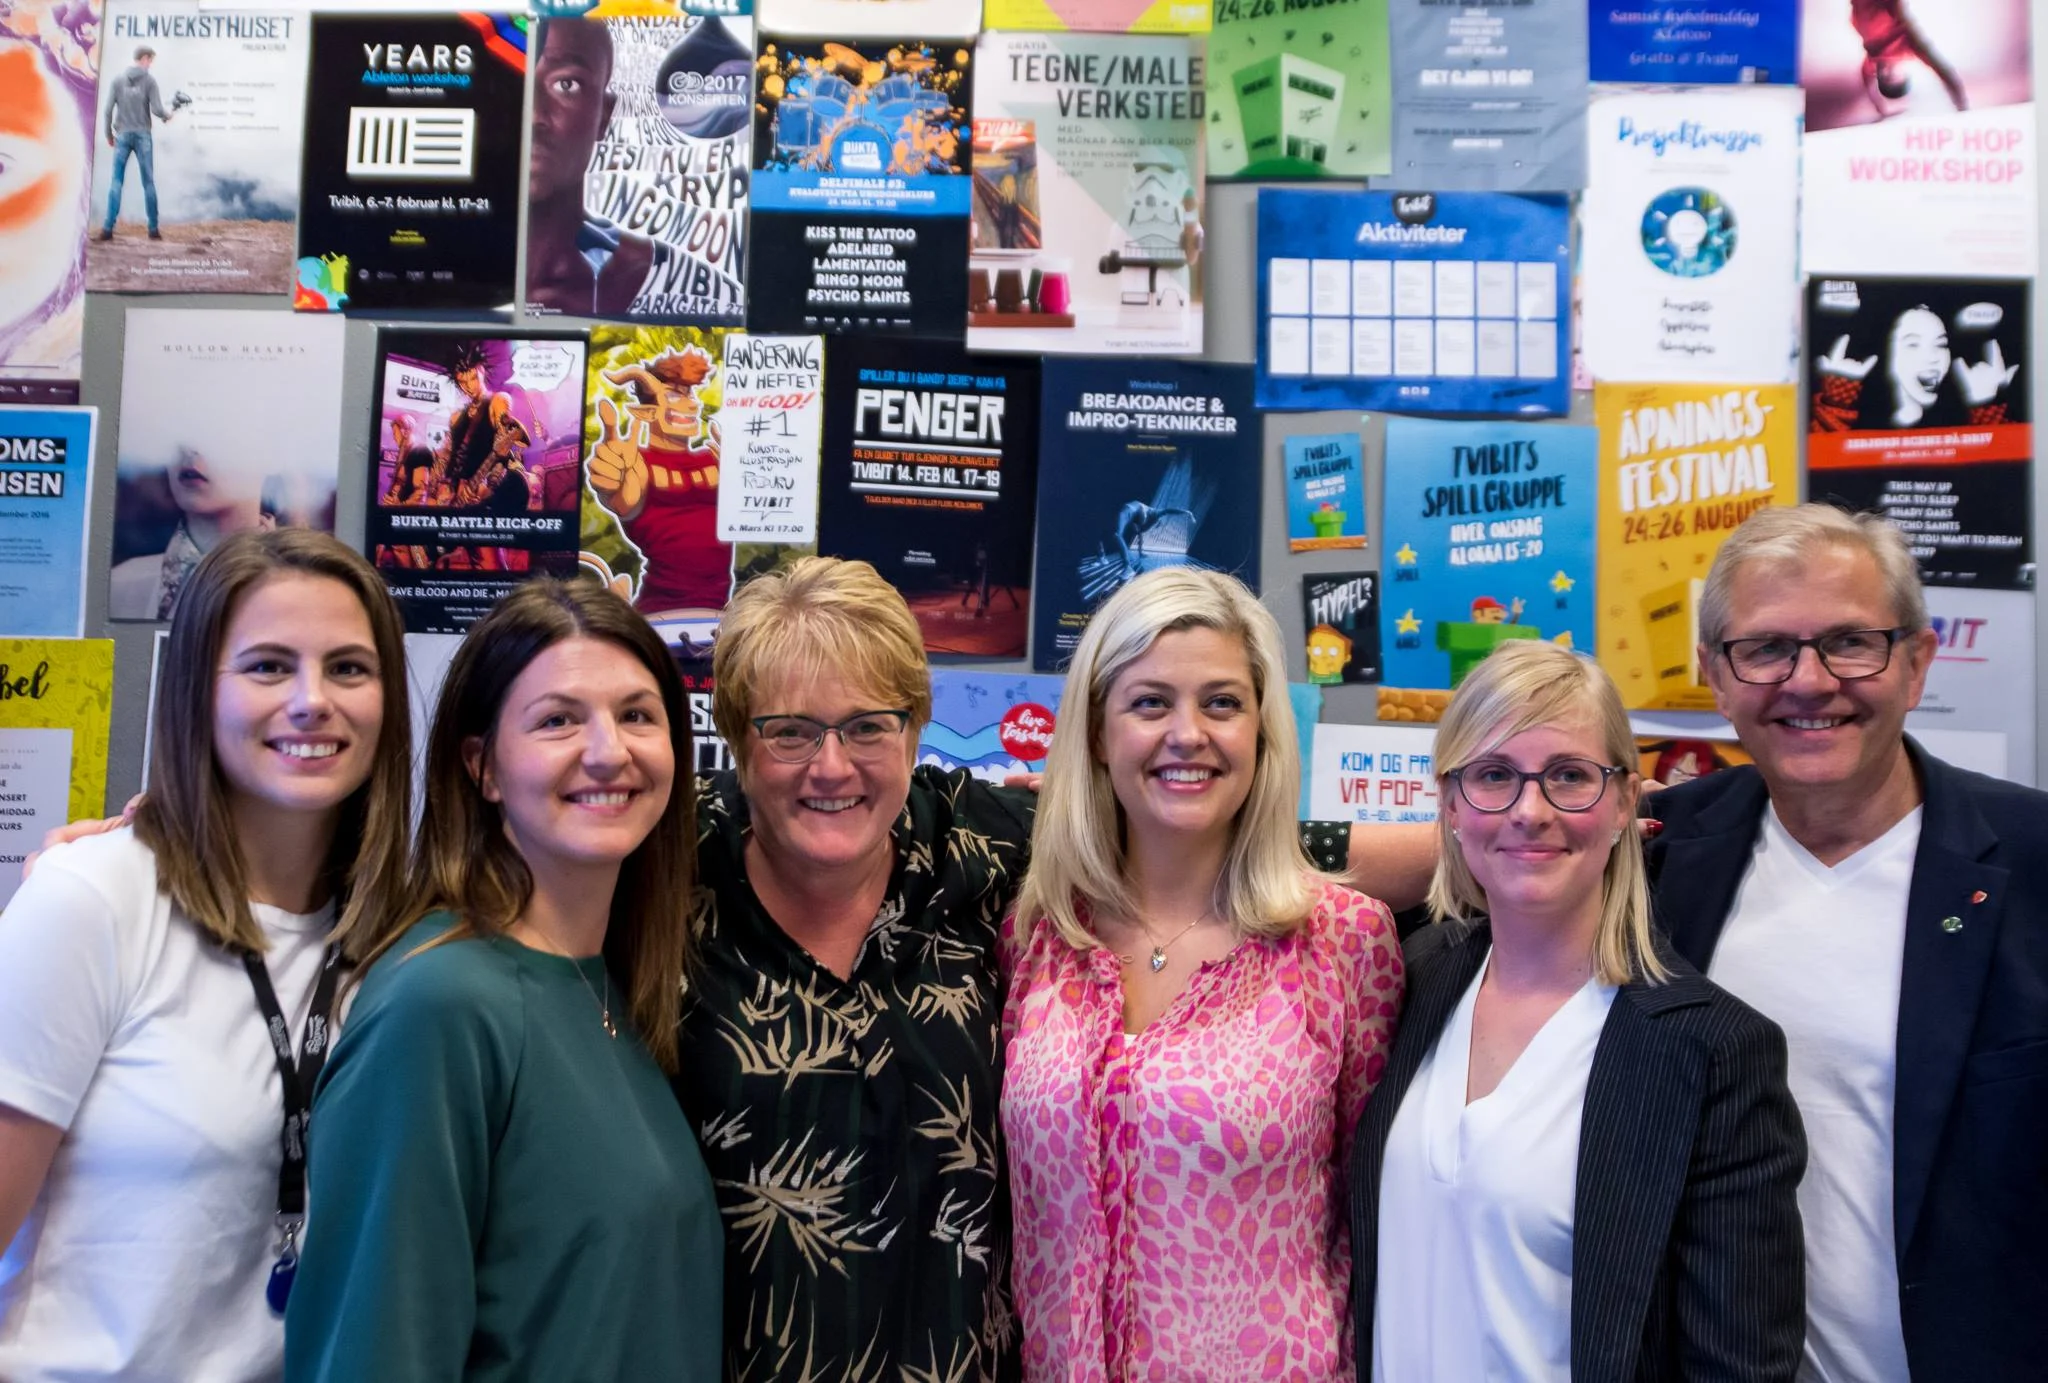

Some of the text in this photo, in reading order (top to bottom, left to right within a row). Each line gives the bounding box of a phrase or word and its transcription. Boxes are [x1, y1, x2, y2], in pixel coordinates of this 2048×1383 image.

[115, 15, 293, 39] FILMVEKSTHUSET
[1008, 41, 1048, 50] GRATIS
[363, 43, 473, 69] YEARS
[362, 69, 471, 87] Ableton workshop
[1009, 55, 1203, 86] TEGNE/MALE
[610, 82, 655, 92] GRATIS
[704, 75, 746, 92] 2017
[668, 94, 746, 106] KONSERTEN
[1057, 89, 1205, 120] VERKSTED
[843, 141, 878, 154] BUKTA
[1057, 136, 1107, 145] MAGNAR
[1905, 129, 2023, 152] HIP HOP
[1850, 157, 2023, 183] WORKSHOP
[655, 165, 749, 210] KRYP
[328, 194, 364, 208] Tvibit,
[396, 196, 440, 208] februar
[806, 226, 916, 241] KISS THE TATTOO
[1358, 222, 1467, 243] Aktiviteter
[827, 242, 894, 256] ADELHEID
[643, 239, 740, 302] TVIBIT
[813, 257, 906, 272] LAMENTATION
[815, 273, 903, 288] RINGO MOON
[630, 293, 720, 315] PARKGATA
[807, 288, 910, 304] PSYCHO SAINTS
[164, 345, 228, 353] HOLLOW
[726, 337, 819, 371] LANSERING
[401, 374, 441, 392] BUKTA
[726, 373, 818, 390] AV HEFTET
[1129, 379, 1173, 391] Workshop
[739, 396, 756, 408] MY
[758, 391, 816, 410] GOD!
[1082, 392, 1225, 413] BREAKDANCE &
[854, 388, 1006, 441] PENGER
[1068, 412, 1238, 433] IMPRO-TEKNIKKER
[744, 411, 797, 437] #1
[1620, 390, 1775, 461] ÅPNINGS-
[1452, 440, 1539, 478] TVIBITS
[852, 461, 894, 480] TVIBIT
[896, 464, 914, 481] 14.
[916, 466, 940, 483] FEB
[1619, 443, 1775, 513] FESTIVAL
[1890, 481, 1914, 490] THIS
[1914, 481, 1937, 490] WAY
[743, 496, 794, 507] TVIBIT
[1422, 474, 1567, 518] SPILLGRUPPE
[1928, 495, 1960, 505] SLEEP
[391, 515, 563, 531] BUKTA BATTLE KICK-OFF
[739, 524, 761, 533] Mars
[777, 525, 804, 533] 17.00
[1451, 515, 1543, 544] HVER ONSDAG
[1924, 521, 1961, 531] SAINTS
[1942, 534, 1971, 544] WANT
[1987, 535, 2023, 545] DREAM
[1450, 545, 1504, 566] KLOKKA
[414, 587, 448, 598] BLOOD
[449, 587, 471, 598] AND
[473, 588, 488, 598] DIE
[1311, 577, 1373, 626] HYBEL?
[1019, 709, 1051, 727] live
[1340, 752, 1374, 773] KOM
[1380, 753, 1401, 773] OG
[1340, 777, 1437, 807] VR POP-
